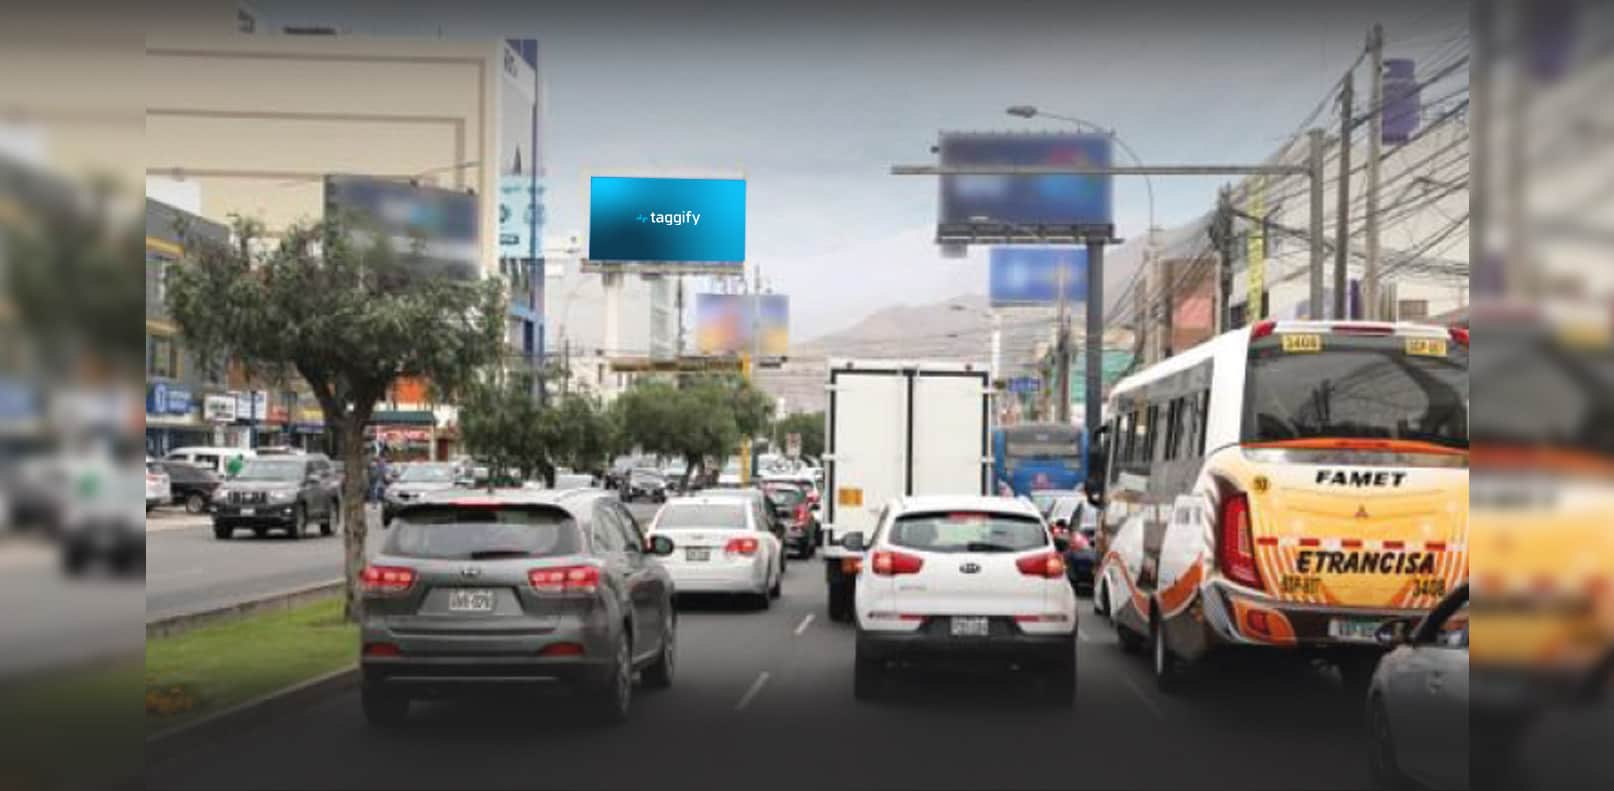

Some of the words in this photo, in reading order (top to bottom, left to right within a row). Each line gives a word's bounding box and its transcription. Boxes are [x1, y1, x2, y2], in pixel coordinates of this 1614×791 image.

[650, 210, 701, 226] taggify
[1315, 469, 1408, 488] FAMET
[1296, 550, 1435, 575] ETRANCISA
